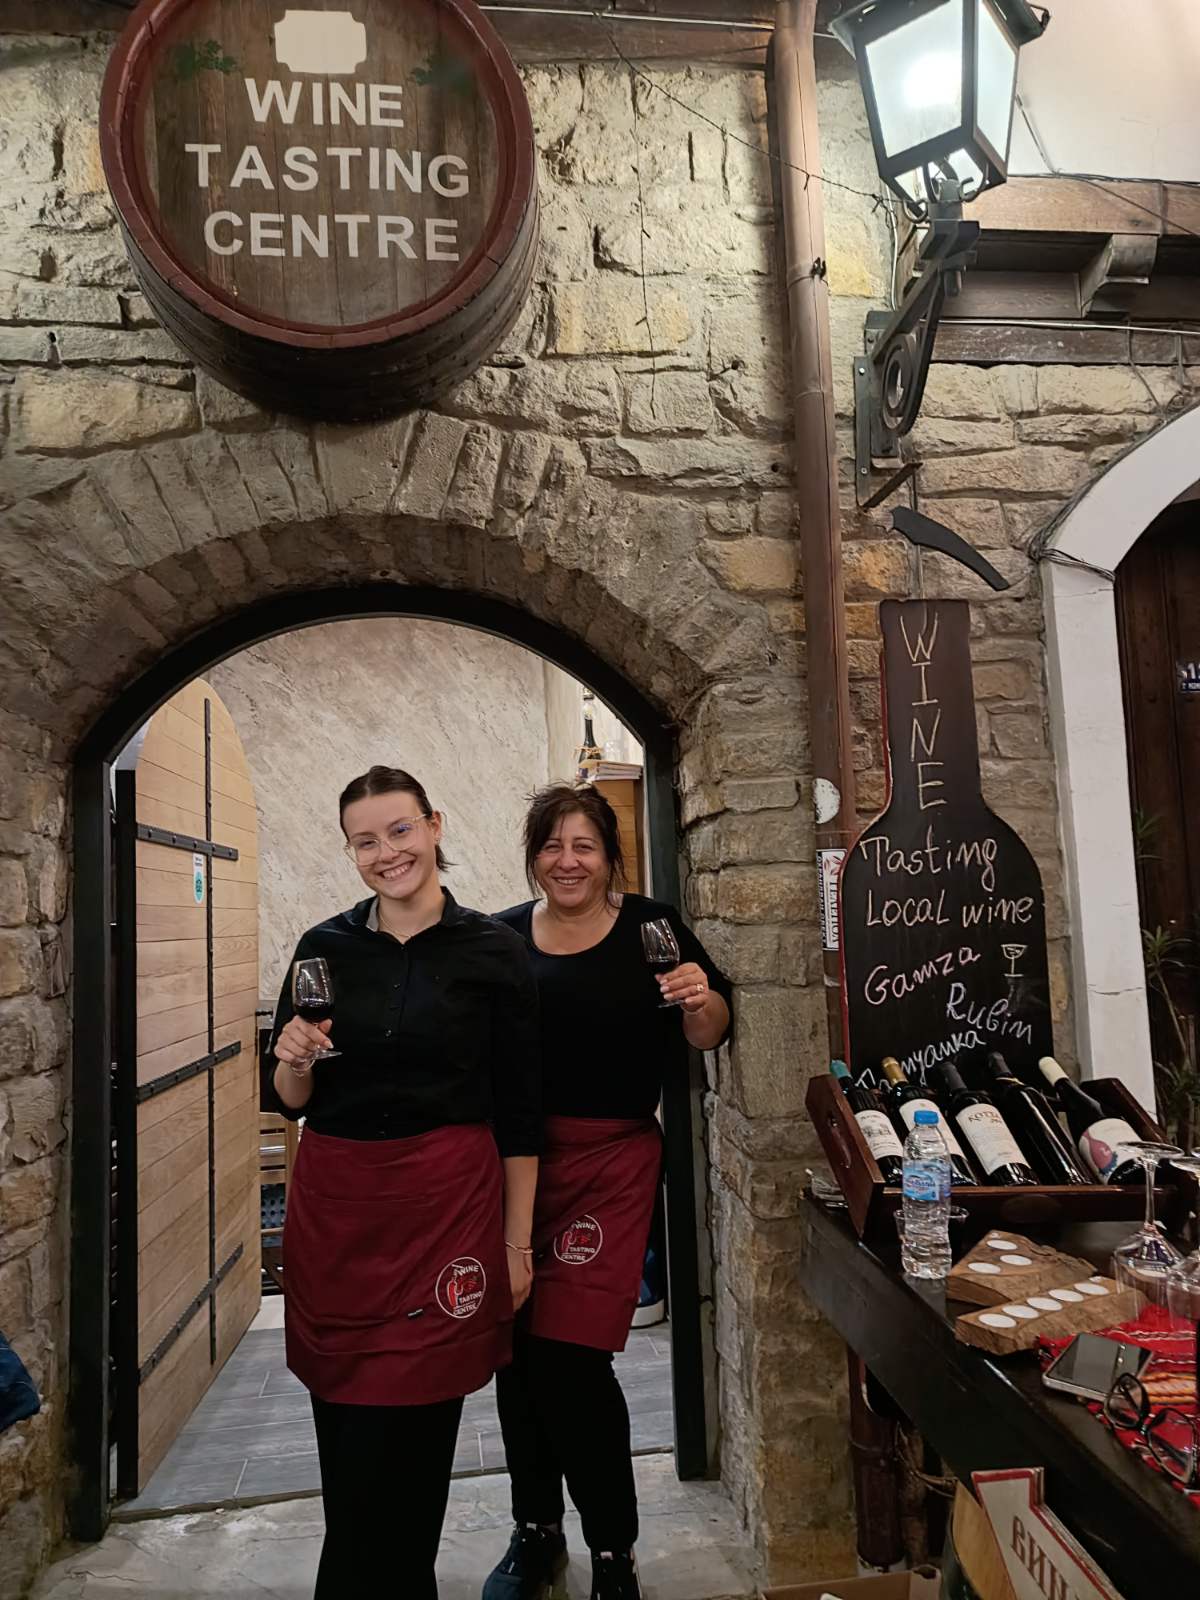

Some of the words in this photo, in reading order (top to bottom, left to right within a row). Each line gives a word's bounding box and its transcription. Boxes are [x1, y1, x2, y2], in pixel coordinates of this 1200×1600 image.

[245, 78, 404, 128] WINE
[185, 143, 469, 198] TASTING
[204, 210, 459, 261] CENTRE
[900, 613, 947, 810] WINE
[859, 824, 998, 892] Tasting
[962, 896, 1034, 928] wine
[865, 947, 982, 1005] Gamza
[946, 982, 1033, 1046] Rubin
[575, 1220, 597, 1231] WINE
[457, 1264, 480, 1276] WINE
[1009, 1515, 1080, 1600] ВИН
